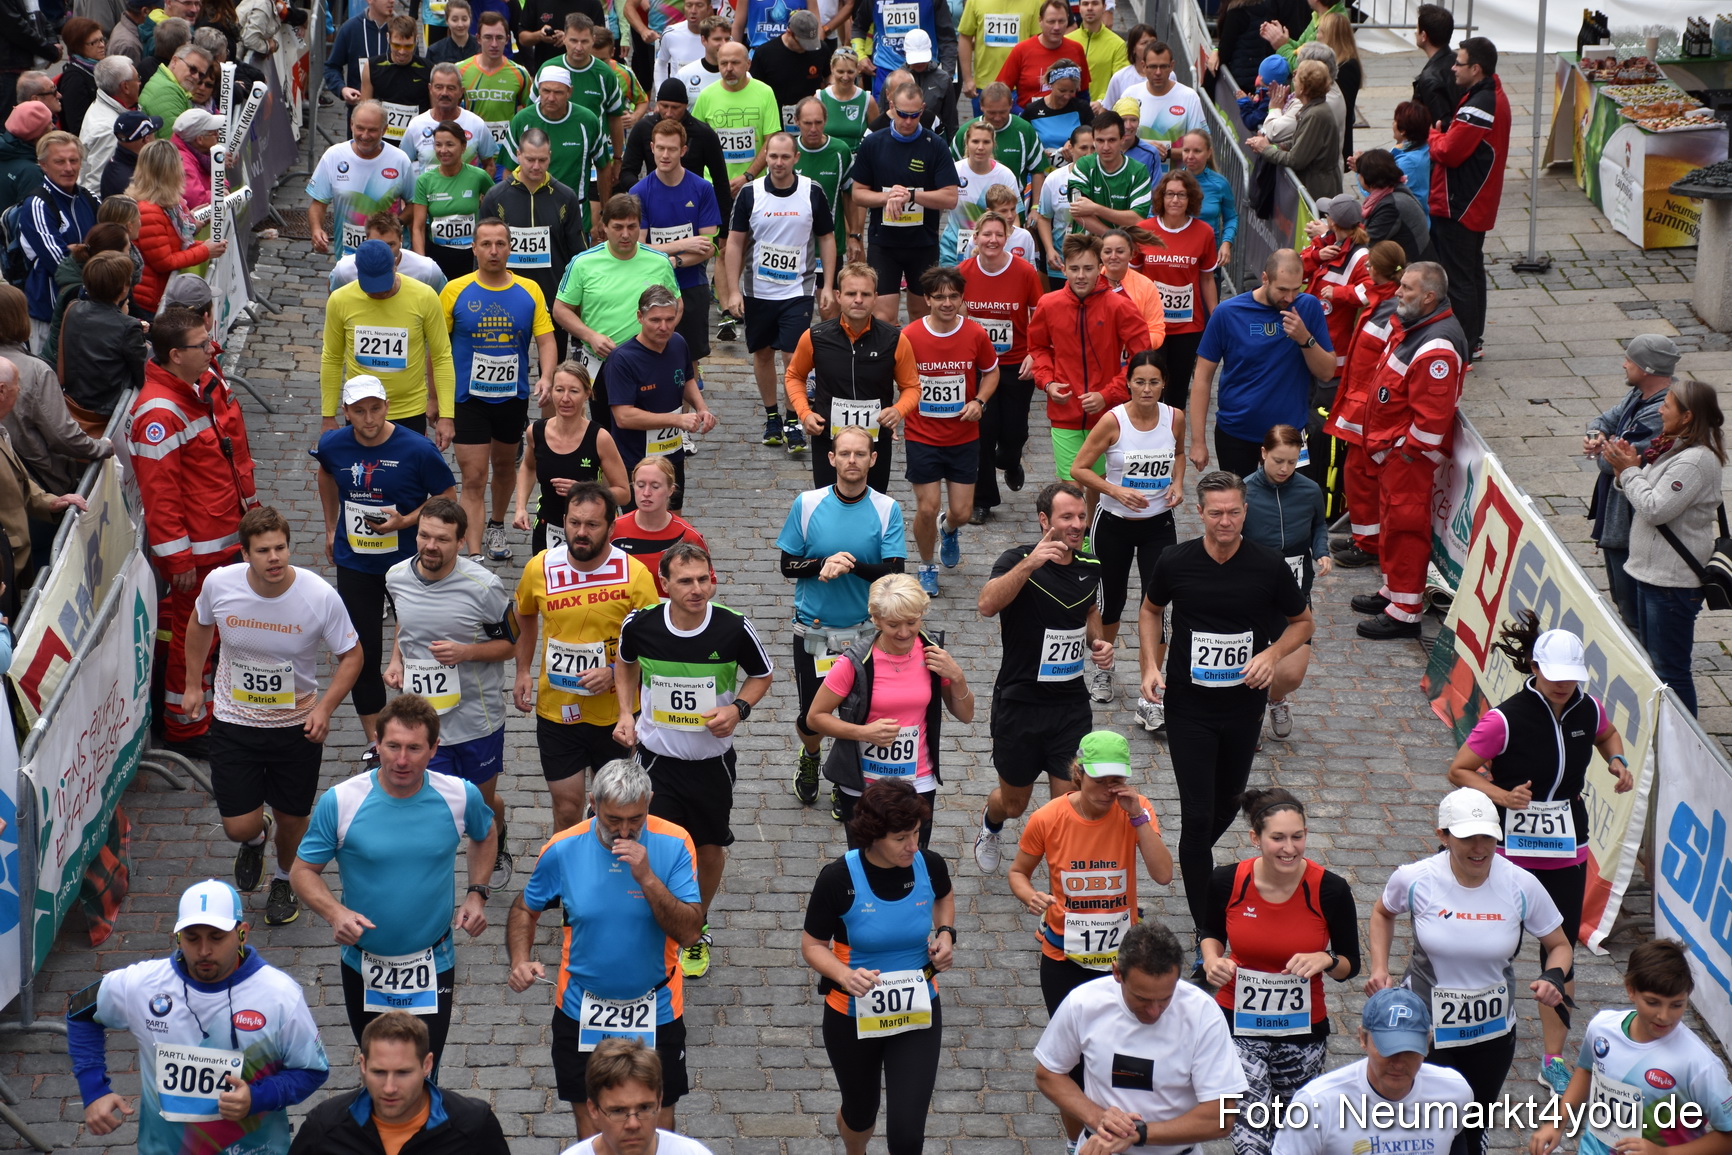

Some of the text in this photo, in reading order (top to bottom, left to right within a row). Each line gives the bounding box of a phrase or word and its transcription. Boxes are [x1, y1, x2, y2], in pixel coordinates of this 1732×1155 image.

[886, 11, 917, 26] 2019
[987, 21, 1018, 36] 2110
[220, 69, 231, 117] Laufsport
[465, 89, 514, 101] BOCK
[241, 101, 257, 125] BMW
[720, 136, 752, 151] 2153
[214, 170, 224, 199] BMW
[436, 223, 472, 239] 2050
[509, 236, 547, 253] 2454
[518, 255, 538, 263] Volker
[761, 251, 797, 271] 2694
[355, 329, 400, 338] PARTL Neumarkt
[359, 337, 404, 356] 2214
[371, 358, 390, 368] Hans
[916, 361, 966, 371] NEUMARKT
[474, 364, 516, 382] 2726
[922, 384, 961, 402] 2631
[929, 403, 956, 413] Gerhard
[841, 410, 871, 427] 111
[1127, 460, 1171, 478] 2405
[1129, 479, 1154, 489] Barbara
[356, 538, 384, 549] Werner
[546, 588, 631, 612] MAX BÖGL
[226, 615, 293, 635] Continental
[1046, 633, 1066, 641] PARTL
[1192, 636, 1245, 646] PARTL Neumarkt
[548, 643, 566, 652] PARTL
[551, 652, 600, 675] 2704
[1198, 645, 1249, 667] 2766
[231, 661, 283, 674] PARTL Neumarkt
[1051, 663, 1080, 676] Christian
[243, 672, 282, 692] 359
[411, 672, 448, 694] 512
[1203, 670, 1240, 681] Christian
[652, 680, 705, 690] PARTL Neumarkt
[247, 693, 278, 704] Patrick
[670, 690, 697, 712] 65
[667, 714, 700, 725] Markus
[868, 763, 906, 775] Michaela
[1512, 812, 1567, 836] 2751
[1517, 836, 1563, 851] Stephanie
[1070, 860, 1118, 870] 30 Jahre
[1065, 876, 1123, 891] OBI
[199, 893, 208, 912] 1
[1064, 894, 1128, 910] Neumarkt
[1456, 906, 1506, 921] KLEBL
[1066, 919, 1090, 927] PARTL
[1079, 926, 1119, 952] 172
[363, 955, 423, 968] PARTL Neumarkt
[1082, 955, 1117, 966] Sylvana
[369, 964, 431, 990] 2420
[882, 977, 914, 987] Neumarkt
[1237, 973, 1298, 986] PARTL Neumarkt
[386, 996, 413, 1006] Franz
[871, 986, 915, 1014] 307
[1242, 985, 1304, 1012] 2773
[1433, 989, 1495, 1001] PARTL Neumarkt
[588, 1003, 650, 1028] 2292
[1388, 1004, 1413, 1027] P
[1441, 997, 1502, 1025] 2400
[145, 1018, 169, 1029] PARTL
[235, 1014, 263, 1027] Hervis
[879, 1015, 910, 1029] Margit
[1255, 1017, 1289, 1028] Bianka
[1459, 1027, 1485, 1039] Birgit
[158, 1049, 228, 1066] PARTL Neumarkt
[162, 1062, 233, 1095] 3064
[1648, 1070, 1673, 1087] Hervis
[1368, 1135, 1435, 1155] HÄRTEIS
